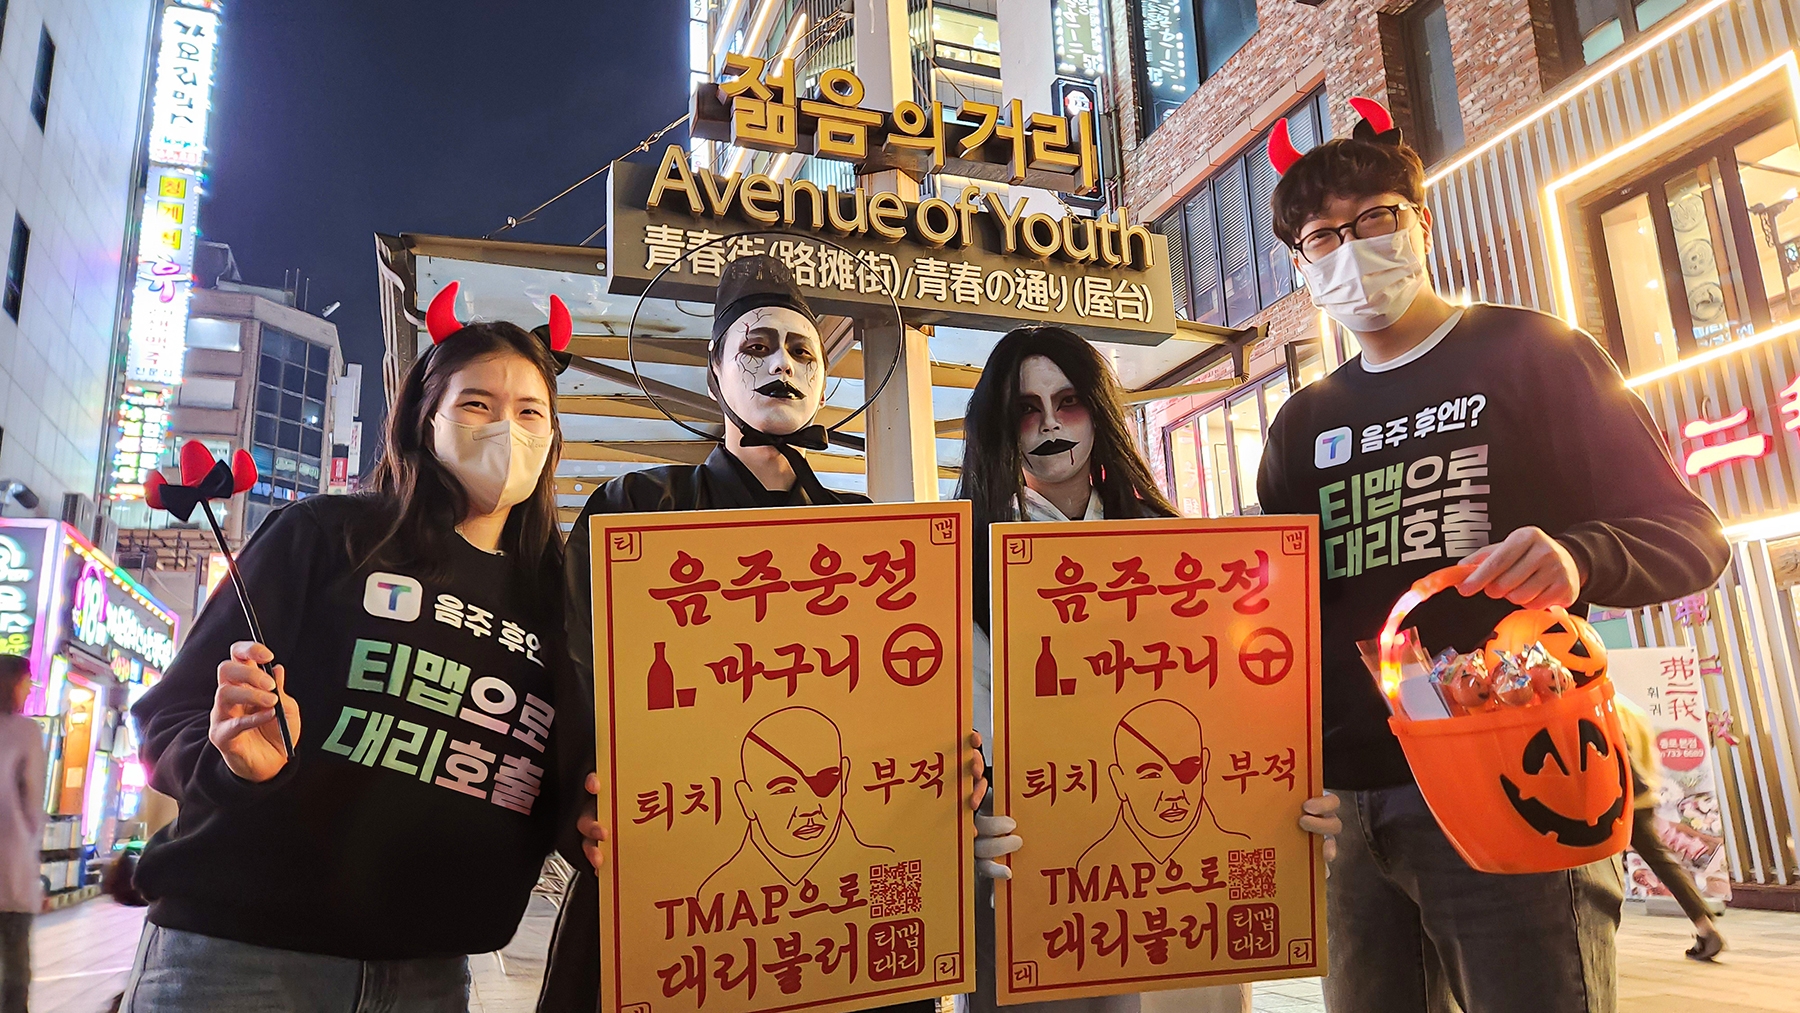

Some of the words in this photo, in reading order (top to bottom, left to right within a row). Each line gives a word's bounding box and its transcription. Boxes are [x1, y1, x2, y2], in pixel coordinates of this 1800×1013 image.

[719, 52, 946, 173] 젊음의
[957, 98, 1094, 194] 거리
[646, 144, 908, 240] Avenue
[916, 185, 981, 247] of
[986, 191, 1156, 269] Youth
[1360, 417, 1408, 454] 음주
[1414, 393, 1486, 439] 후엔?
[1319, 444, 1490, 531] 티맵으로
[613, 533, 634, 556] 티
[934, 518, 954, 540] 맵
[1009, 540, 1026, 559] 티
[1285, 531, 1302, 551] 맵
[1324, 499, 1492, 580] 대리호출
[648, 539, 917, 628] 음주운전
[1037, 549, 1270, 624] 음주운전
[434, 593, 495, 638] 음주
[704, 634, 860, 704] 마구니
[1083, 635, 1219, 695] 마구니
[346, 638, 556, 754] 티맵으로
[321, 705, 545, 816] 대리호출
[1021, 758, 1098, 807] 퇴치
[1221, 747, 1296, 795] 부적
[631, 775, 722, 831] 퇴치
[863, 751, 945, 805] 부적
[654, 872, 868, 941] TMAP으로
[1040, 856, 1228, 906] TMAP으로
[874, 921, 920, 951] 티맵
[1042, 902, 1219, 972] 대리불러
[1231, 931, 1275, 957] 대리
[1232, 906, 1275, 932] 티맵
[657, 922, 858, 1010] 대리불러
[872, 948, 920, 977] 대리
[939, 955, 956, 977] 리
[1013, 964, 1033, 985] 대
[1293, 942, 1309, 962] 리
